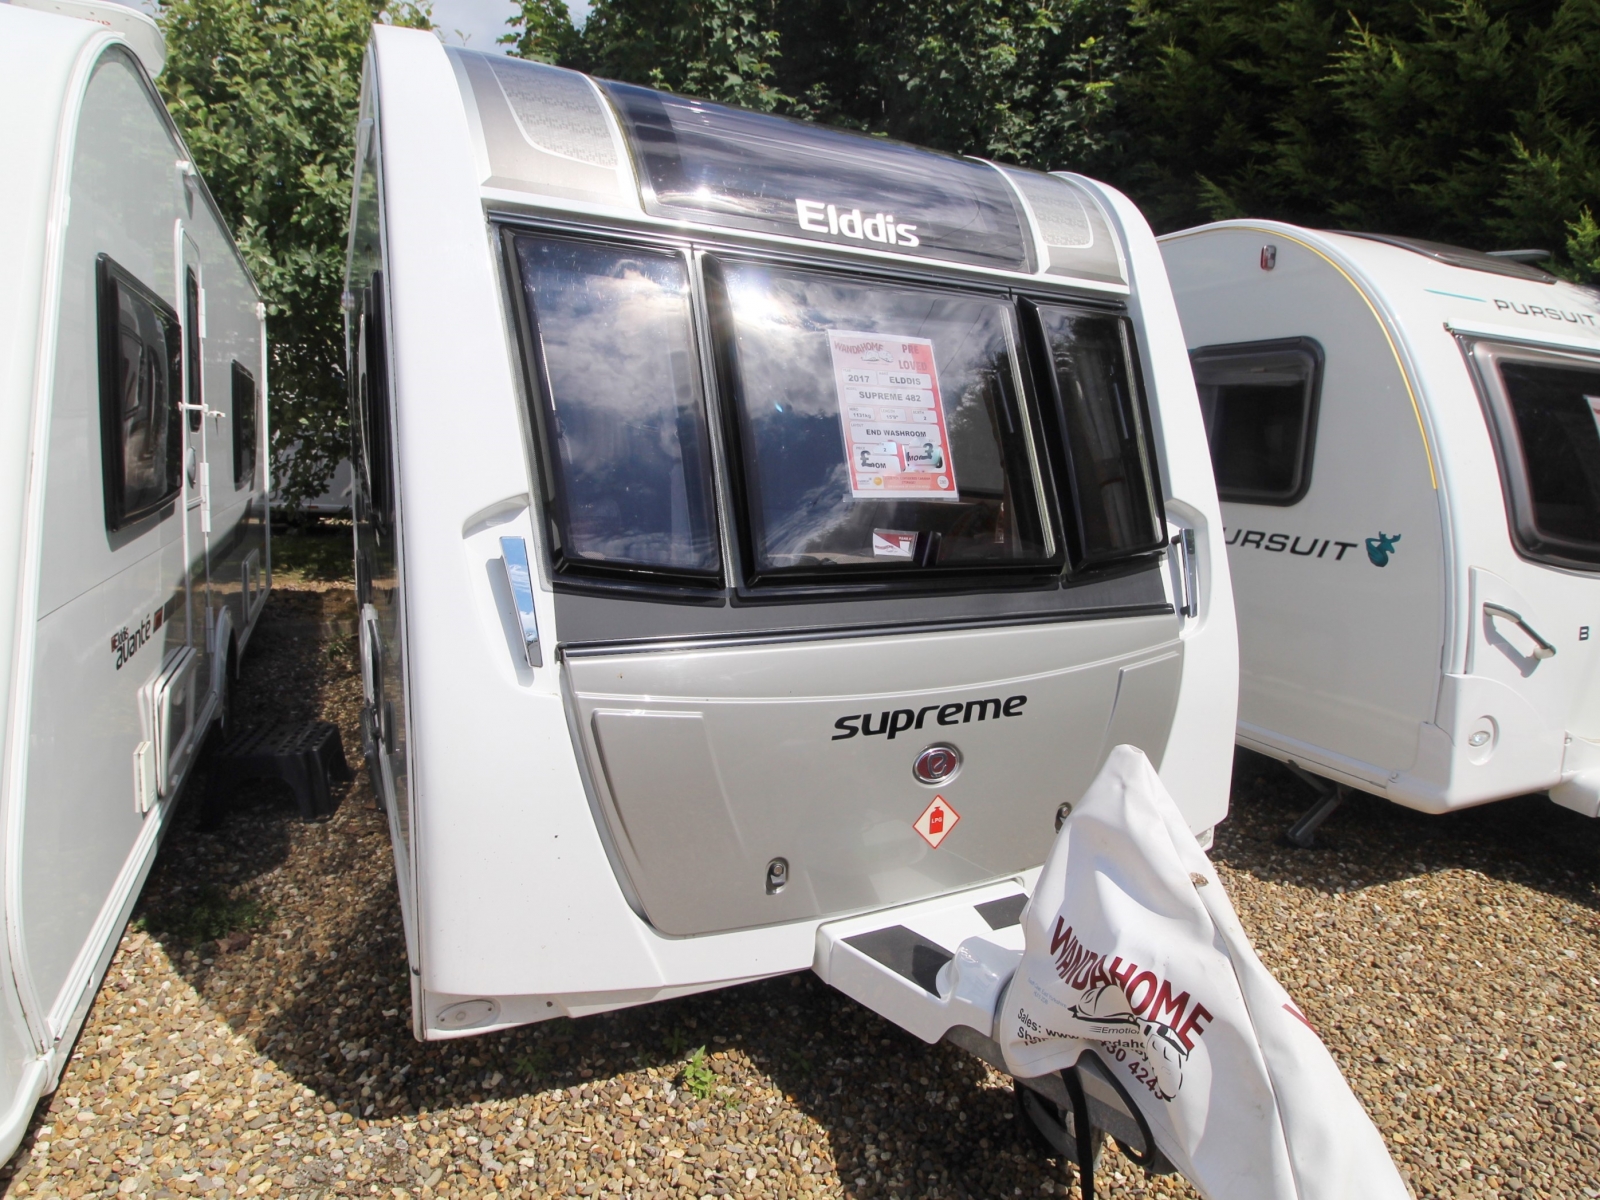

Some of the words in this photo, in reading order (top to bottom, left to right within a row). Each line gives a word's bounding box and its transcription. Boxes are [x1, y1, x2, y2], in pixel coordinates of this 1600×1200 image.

[795, 198, 919, 247] Elddis
[1493, 299, 1595, 326] PURSUIT
[834, 341, 883, 354] WANDAHOME
[902, 344, 919, 354] PRE
[898, 360, 927, 371] LOVED
[848, 374, 869, 383] 2017
[889, 376, 921, 385] ELDDIS
[859, 391, 903, 401] SUPREME
[905, 394, 921, 402] 482
[1223, 527, 1358, 561] URSUIT
[1579, 626, 1589, 641] B
[831, 695, 1027, 740] supreme
[931, 816, 942, 824] LPG
[1050, 915, 1213, 1051] WANDAHOME
[1018, 1008, 1041, 1033] Sales:
